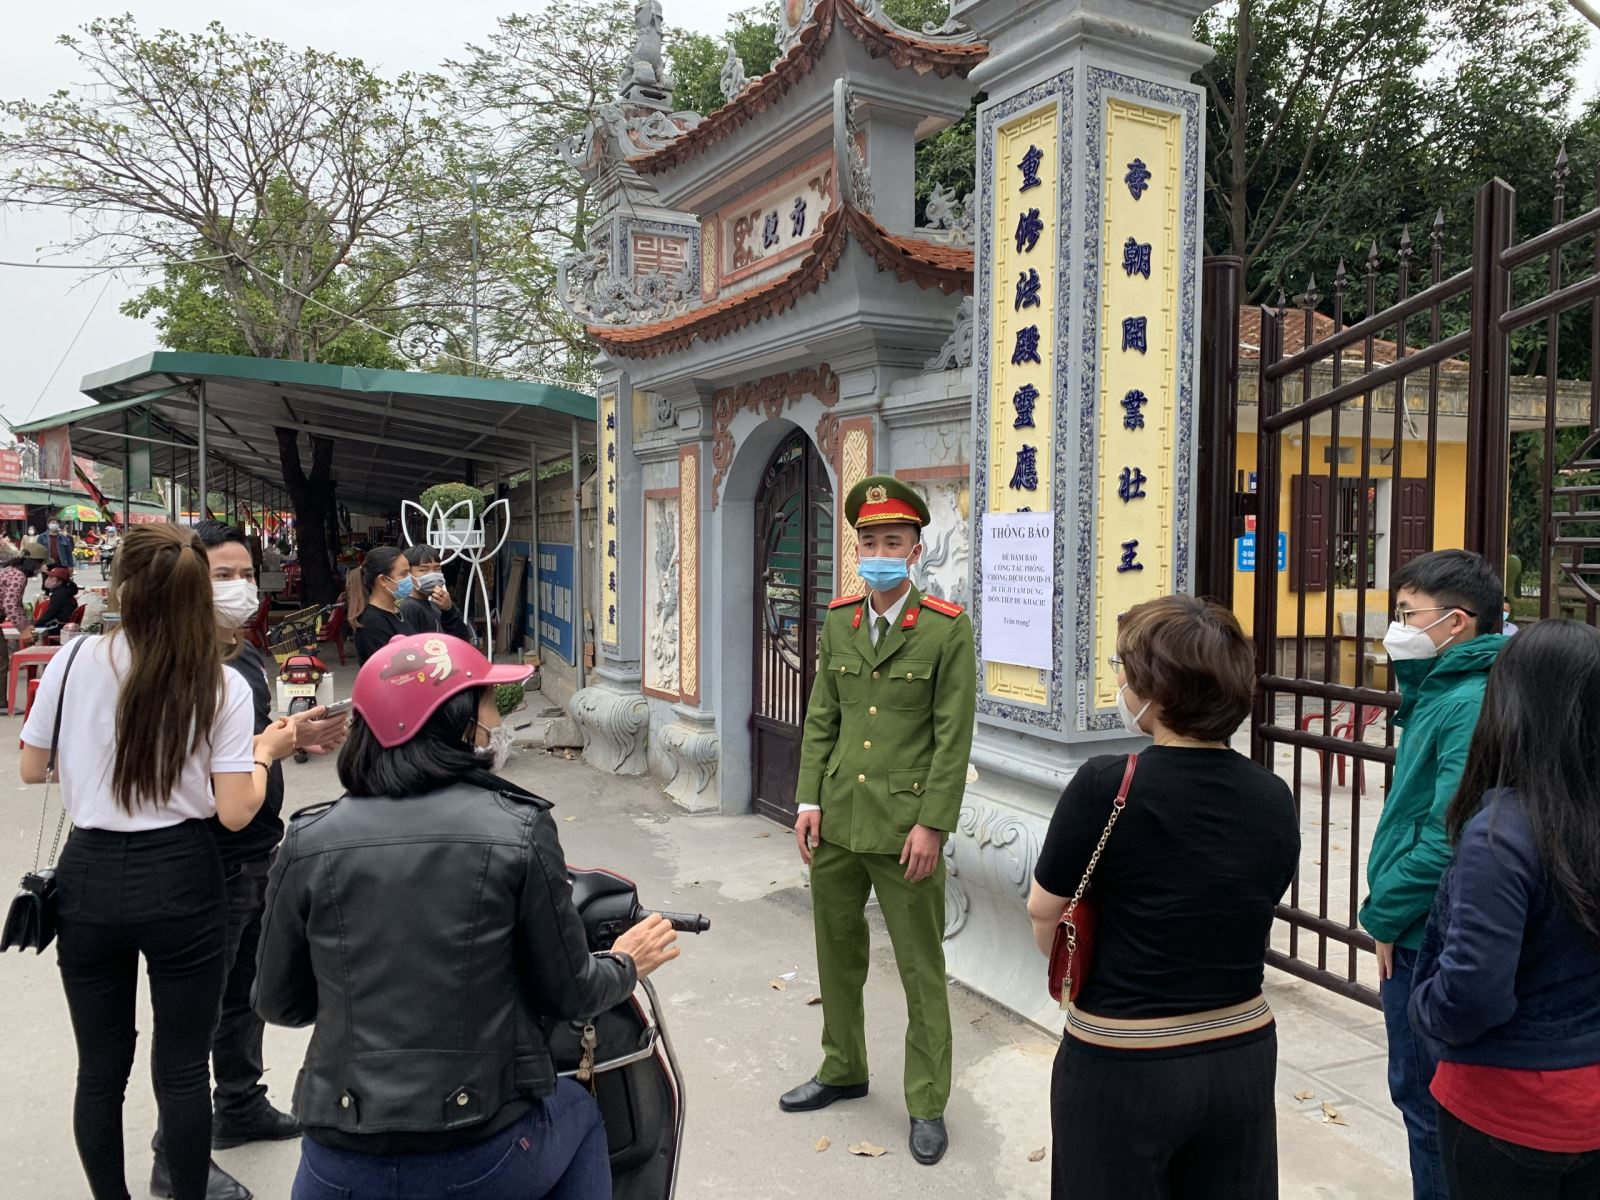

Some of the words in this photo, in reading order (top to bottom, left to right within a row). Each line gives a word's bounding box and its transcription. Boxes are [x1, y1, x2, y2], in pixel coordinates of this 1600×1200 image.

[1008, 143, 1044, 513] 重修法殿靈應
[991, 523, 1025, 539] THÔNG
[1028, 523, 1050, 539] BÁO
